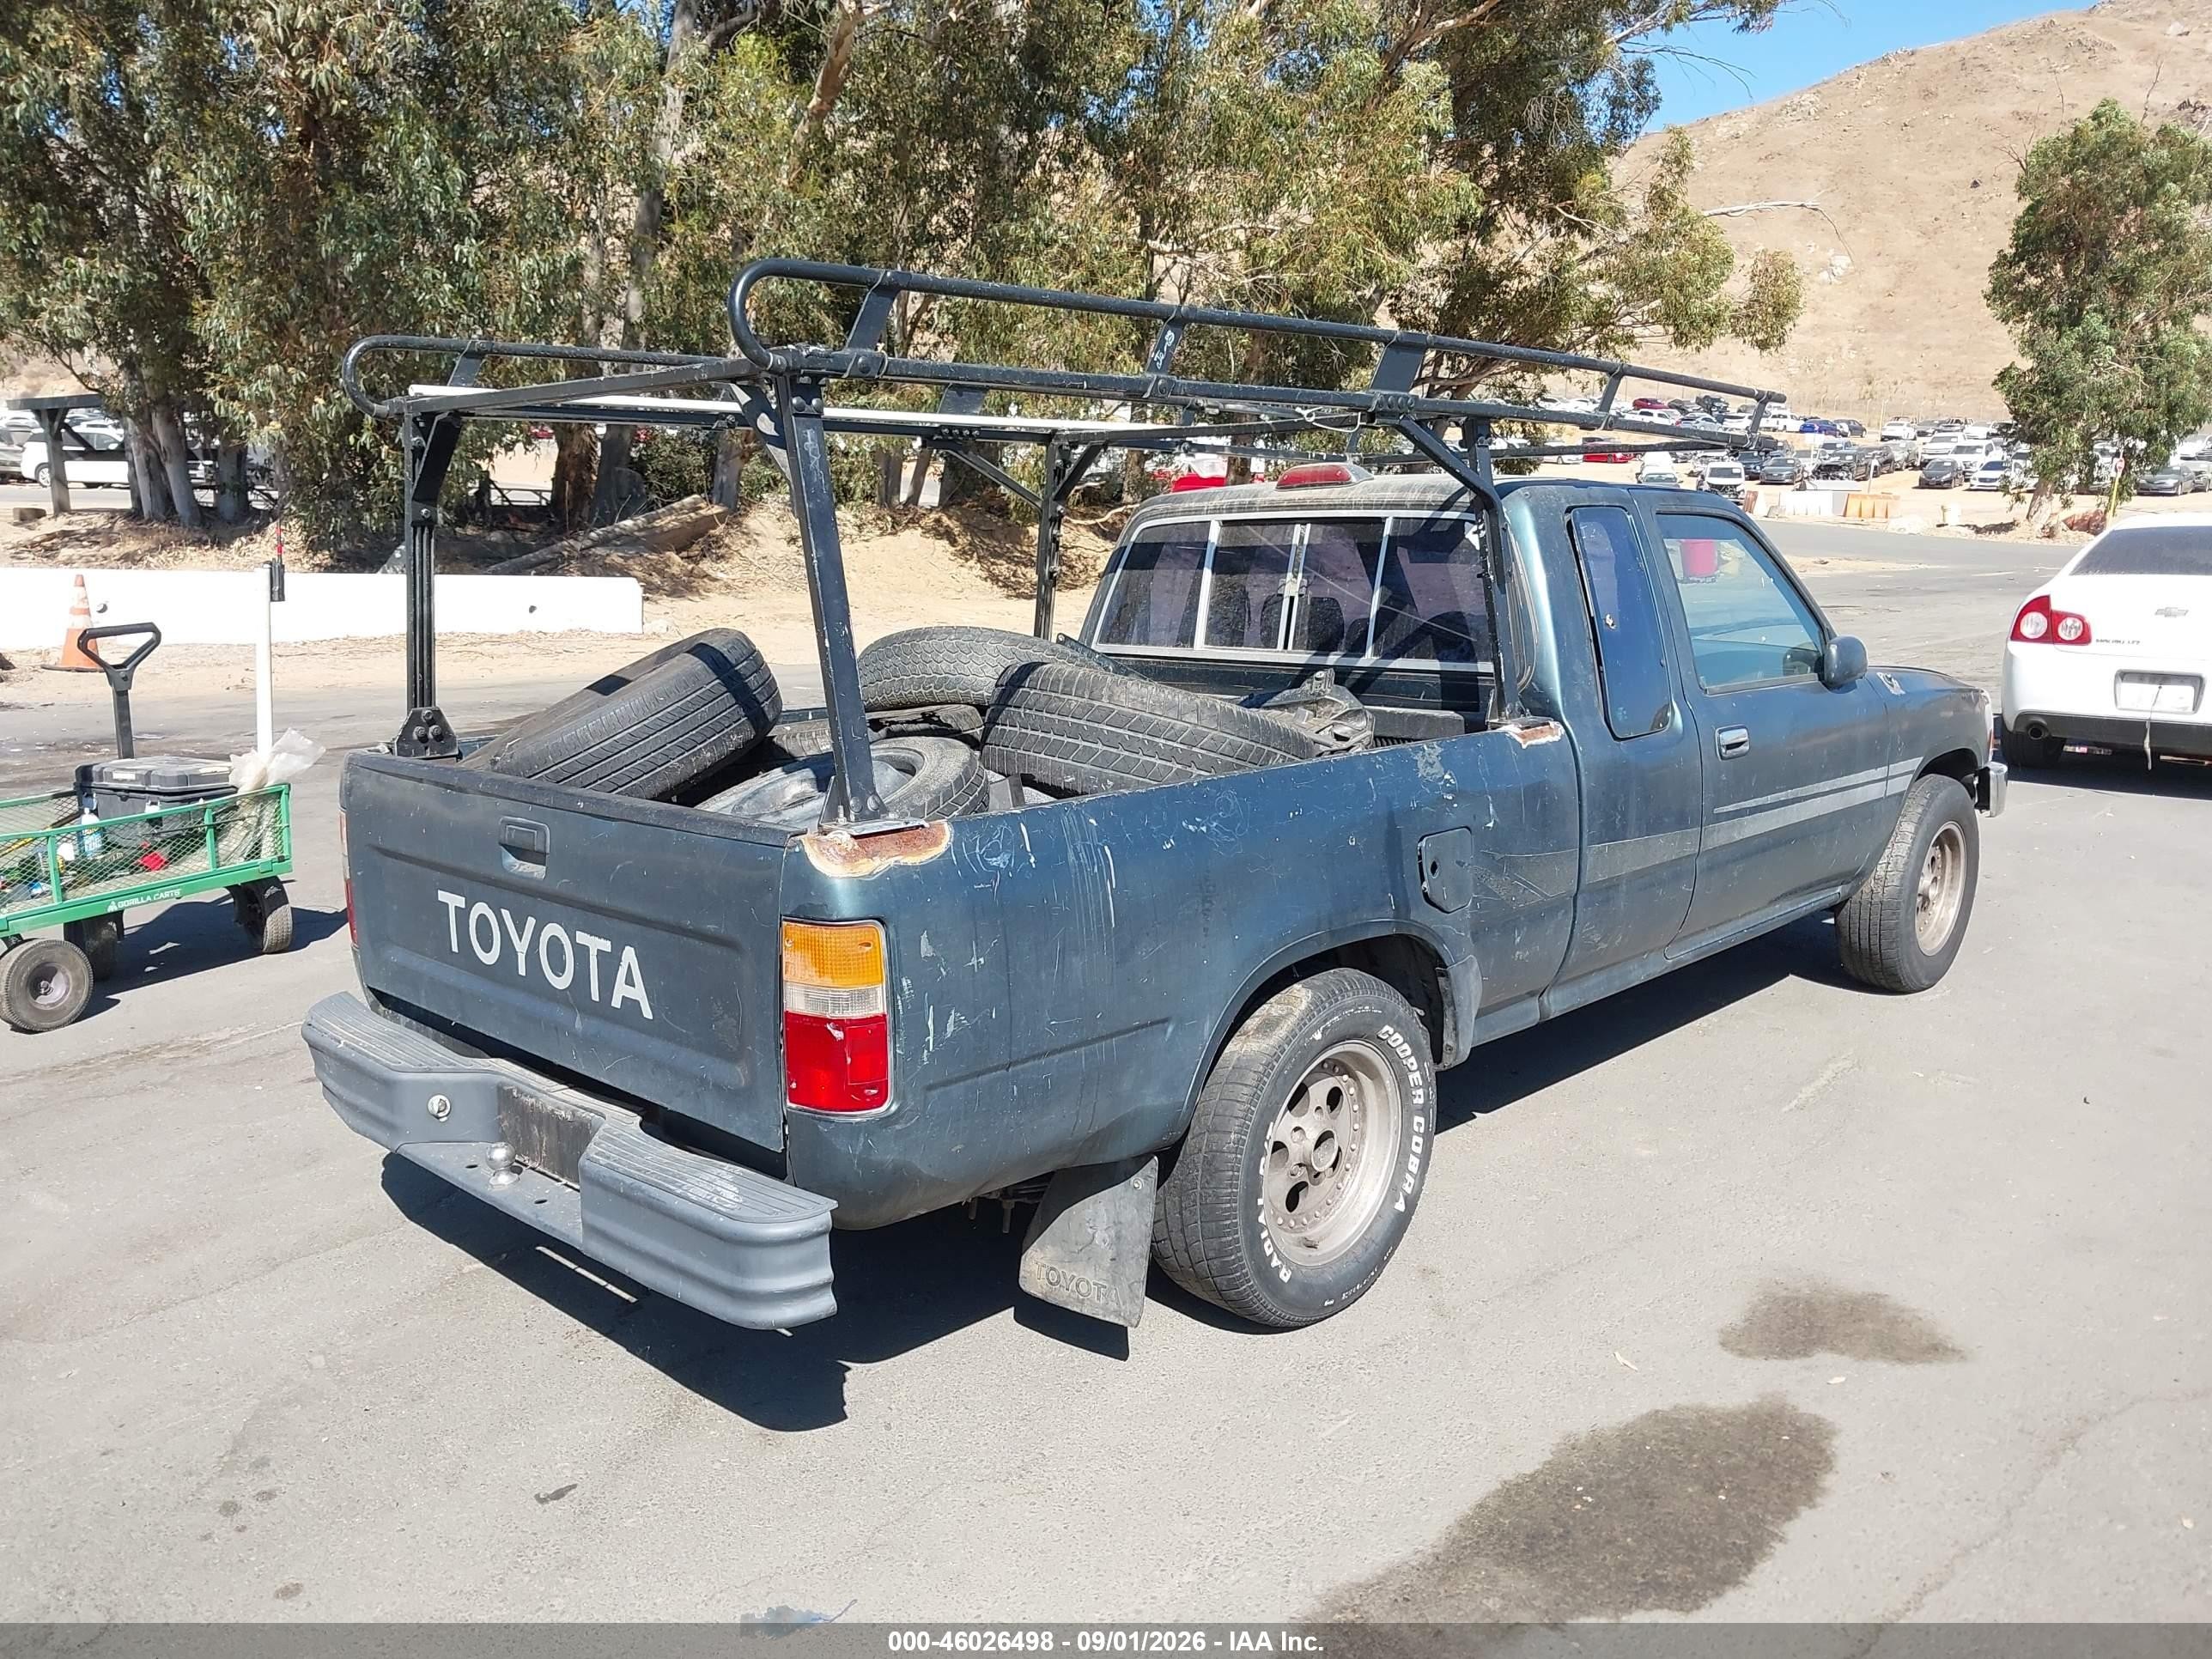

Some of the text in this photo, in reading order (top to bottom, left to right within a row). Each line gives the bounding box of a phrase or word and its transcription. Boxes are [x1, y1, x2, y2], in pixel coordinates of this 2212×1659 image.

[117, 888, 182, 908] GORILLA CARTS
[437, 890, 653, 1020] TOYOTA
[1376, 1024, 1425, 1212] COOPER COBRA
[1033, 1260, 1122, 1306] TOYOTA
